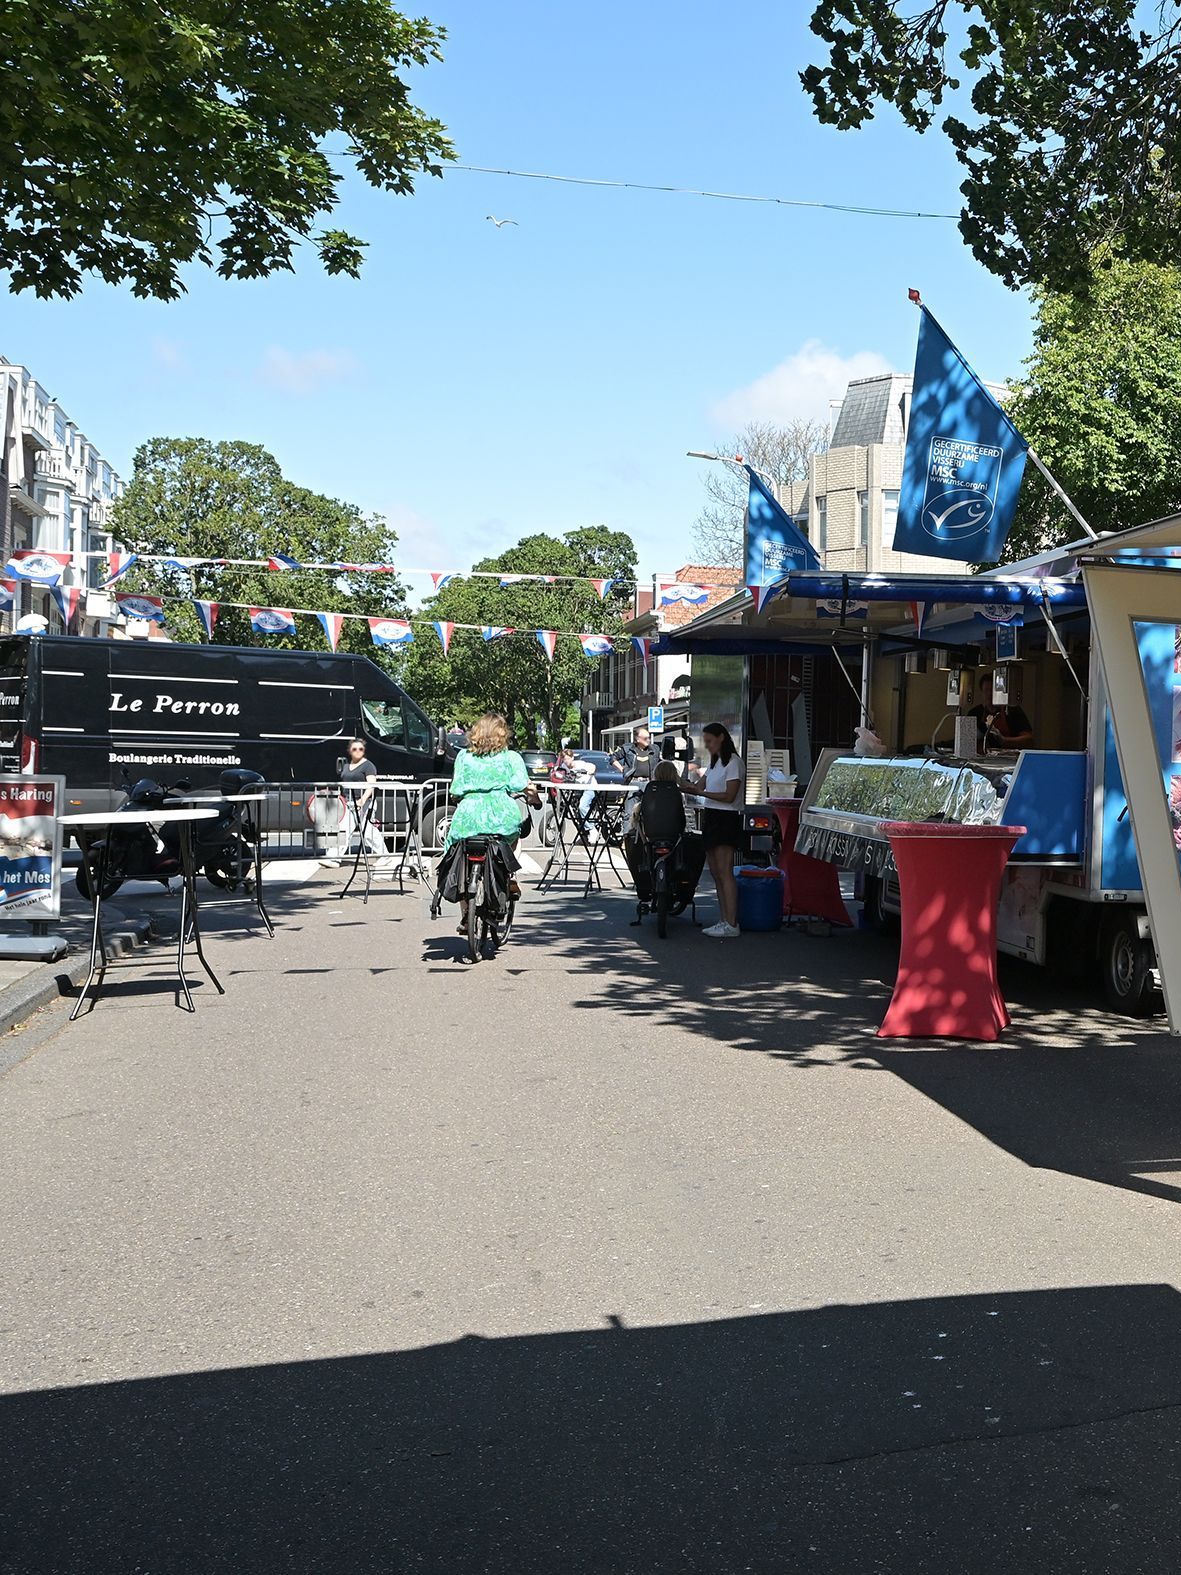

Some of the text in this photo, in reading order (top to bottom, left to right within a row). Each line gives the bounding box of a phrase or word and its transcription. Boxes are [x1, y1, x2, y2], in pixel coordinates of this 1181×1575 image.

[933, 447, 979, 463] DUURZAME
[934, 439, 1000, 458] GECERTIFICEERD
[931, 464, 958, 479] MSC
[929, 475, 988, 491] www.msc.org/nl
[108, 693, 241, 716] Le Perron
[652, 709, 661, 720] P
[108, 753, 241, 765] Boulangerie Traditionelle
[10, 787, 53, 803] Haring
[3, 870, 51, 884] het Mes
